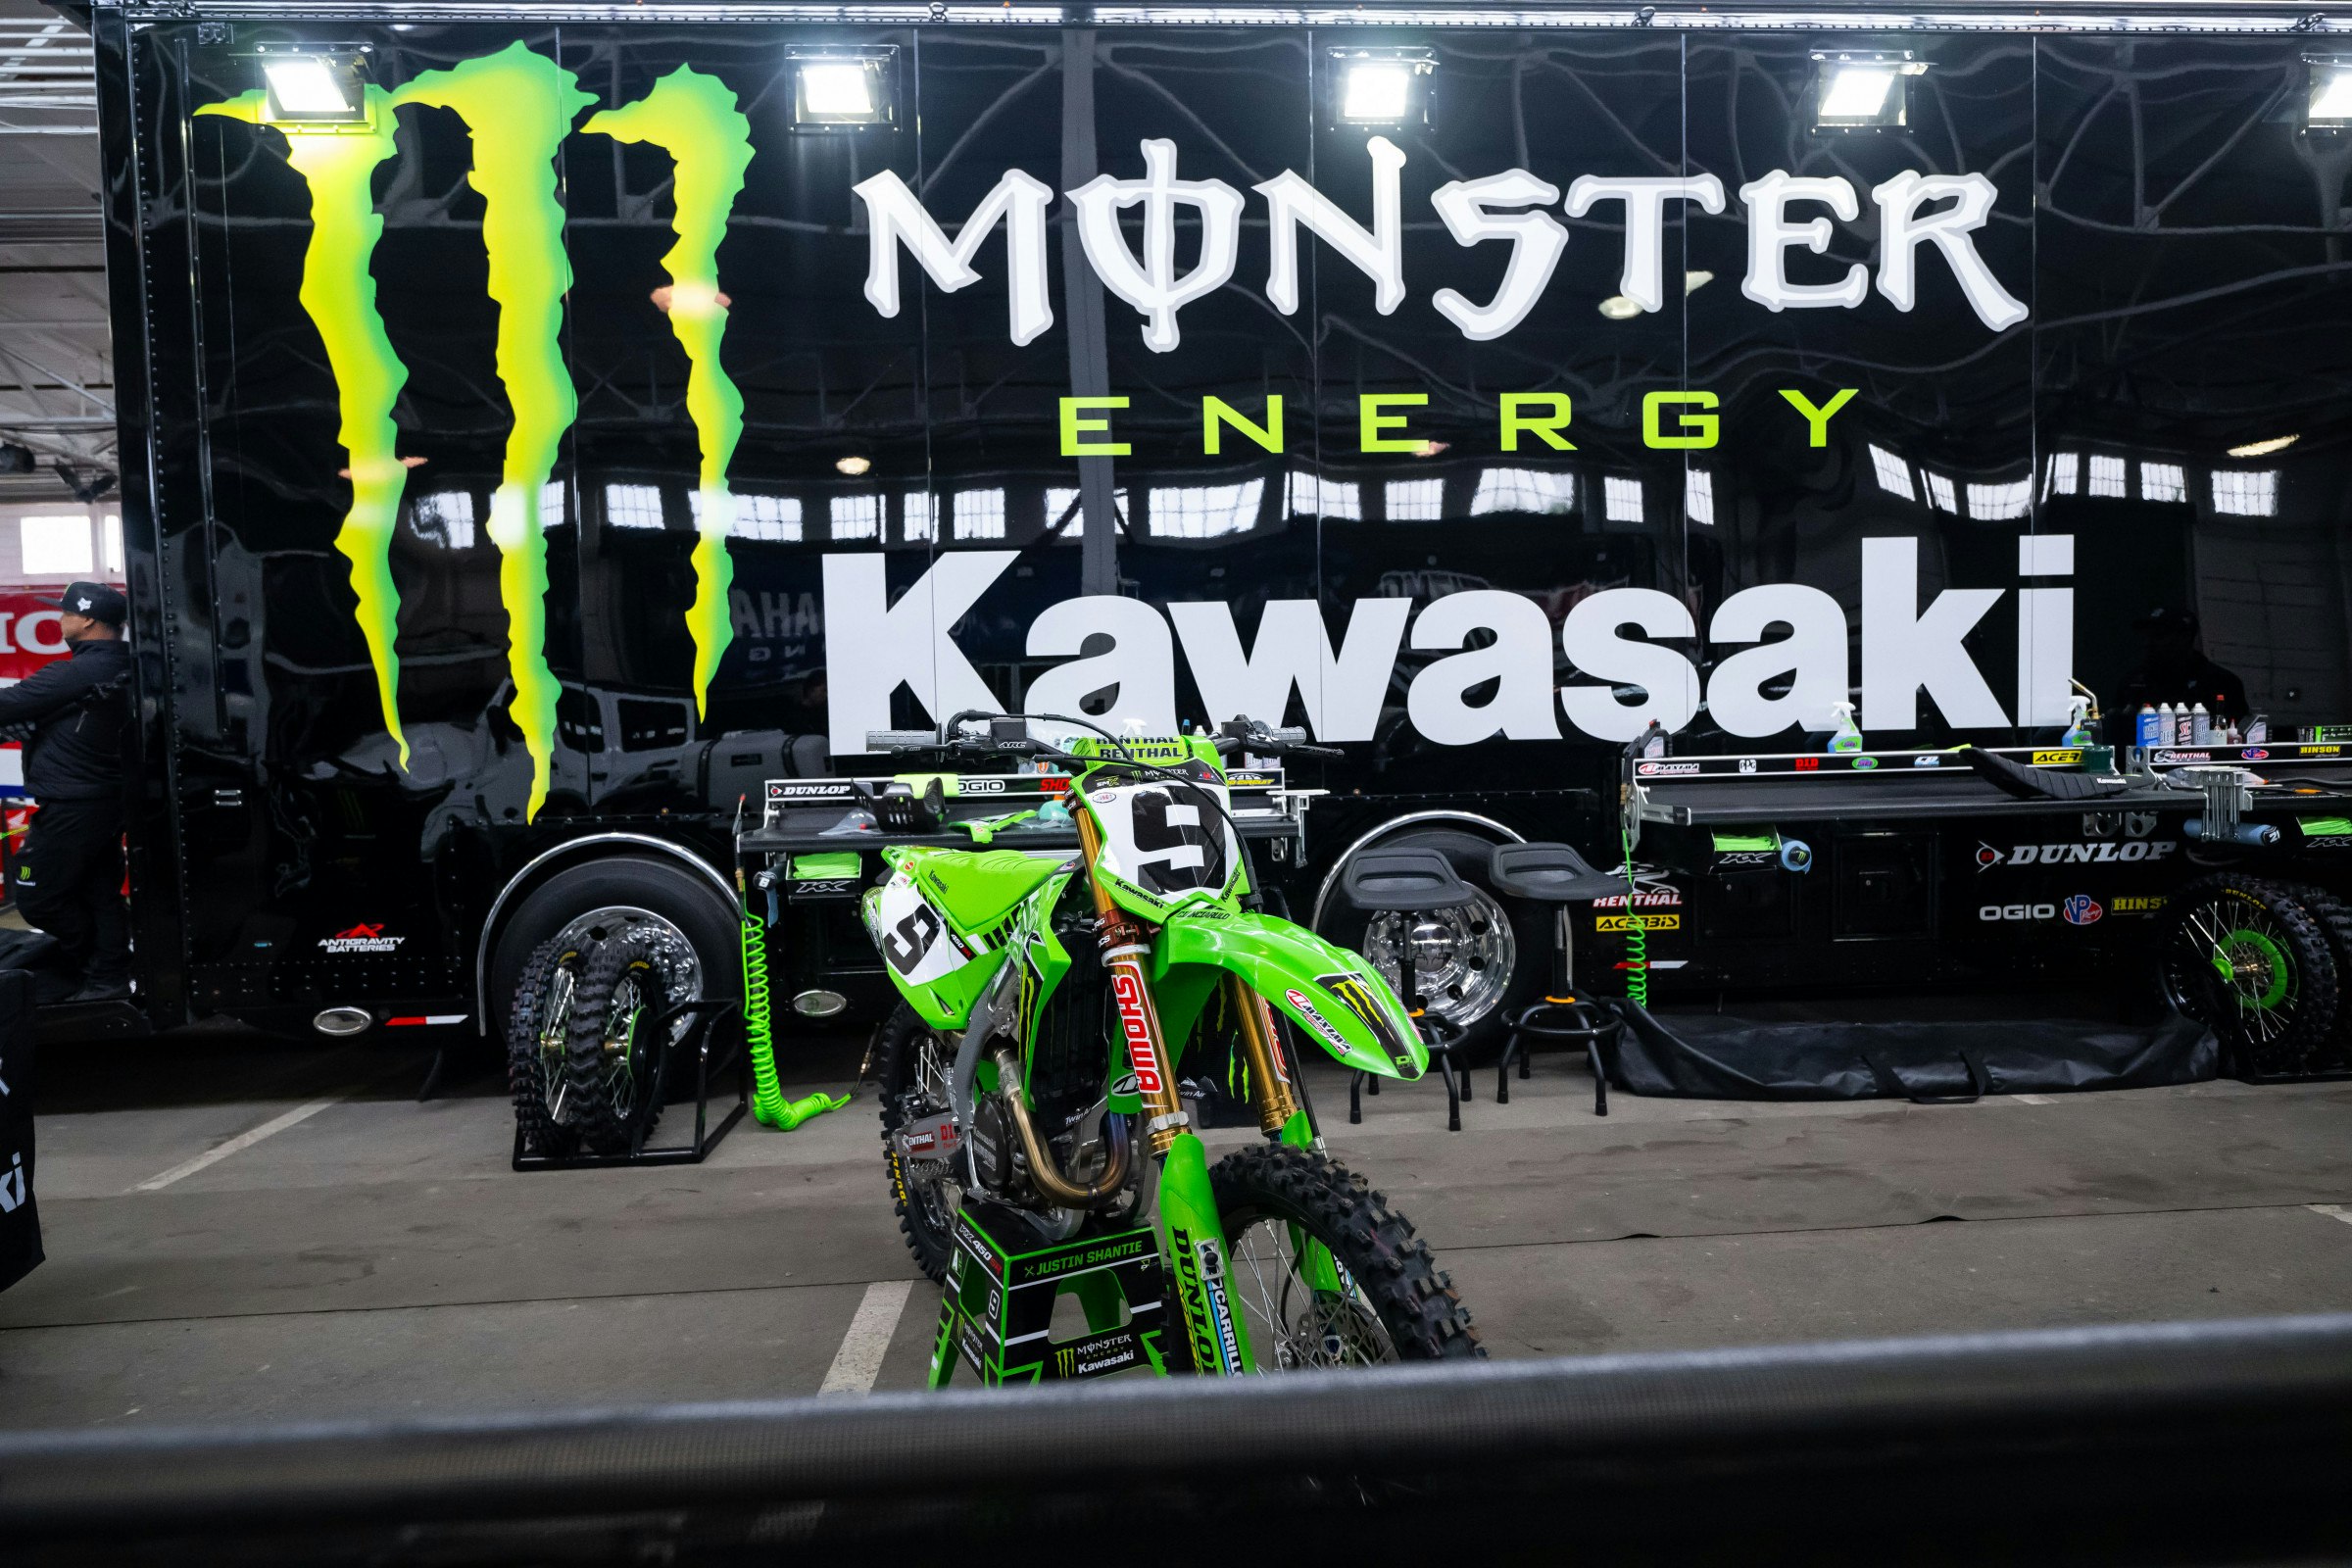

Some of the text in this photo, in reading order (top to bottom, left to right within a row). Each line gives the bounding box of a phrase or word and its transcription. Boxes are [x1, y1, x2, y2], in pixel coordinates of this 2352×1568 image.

[1059, 389, 1859, 456] ENERGY
[821, 534, 2075, 756] Kawasaki
[1100, 747, 1183, 759] RENTHAL
[2035, 752, 2082, 762] ACER
[783, 785, 852, 796] DUNLOP
[1039, 778, 1070, 792] SHO
[2007, 842, 2178, 865] DUNLOP
[928, 869, 950, 895] Kawasaki
[1114, 878, 1165, 909] Kawasaki
[1980, 904, 2055, 921] OGIO
[2064, 895, 2092, 923] VP
[2113, 898, 2168, 910] HINS
[318, 937, 406, 947] ANTIGRAVITY
[326, 944, 396, 954] BATTERIES
[1111, 974, 1163, 1094] SHOWA
[1036, 1240, 1144, 1277] JUSTIN SHANTIE
[1077, 1349, 1135, 1374] Kawasaki
